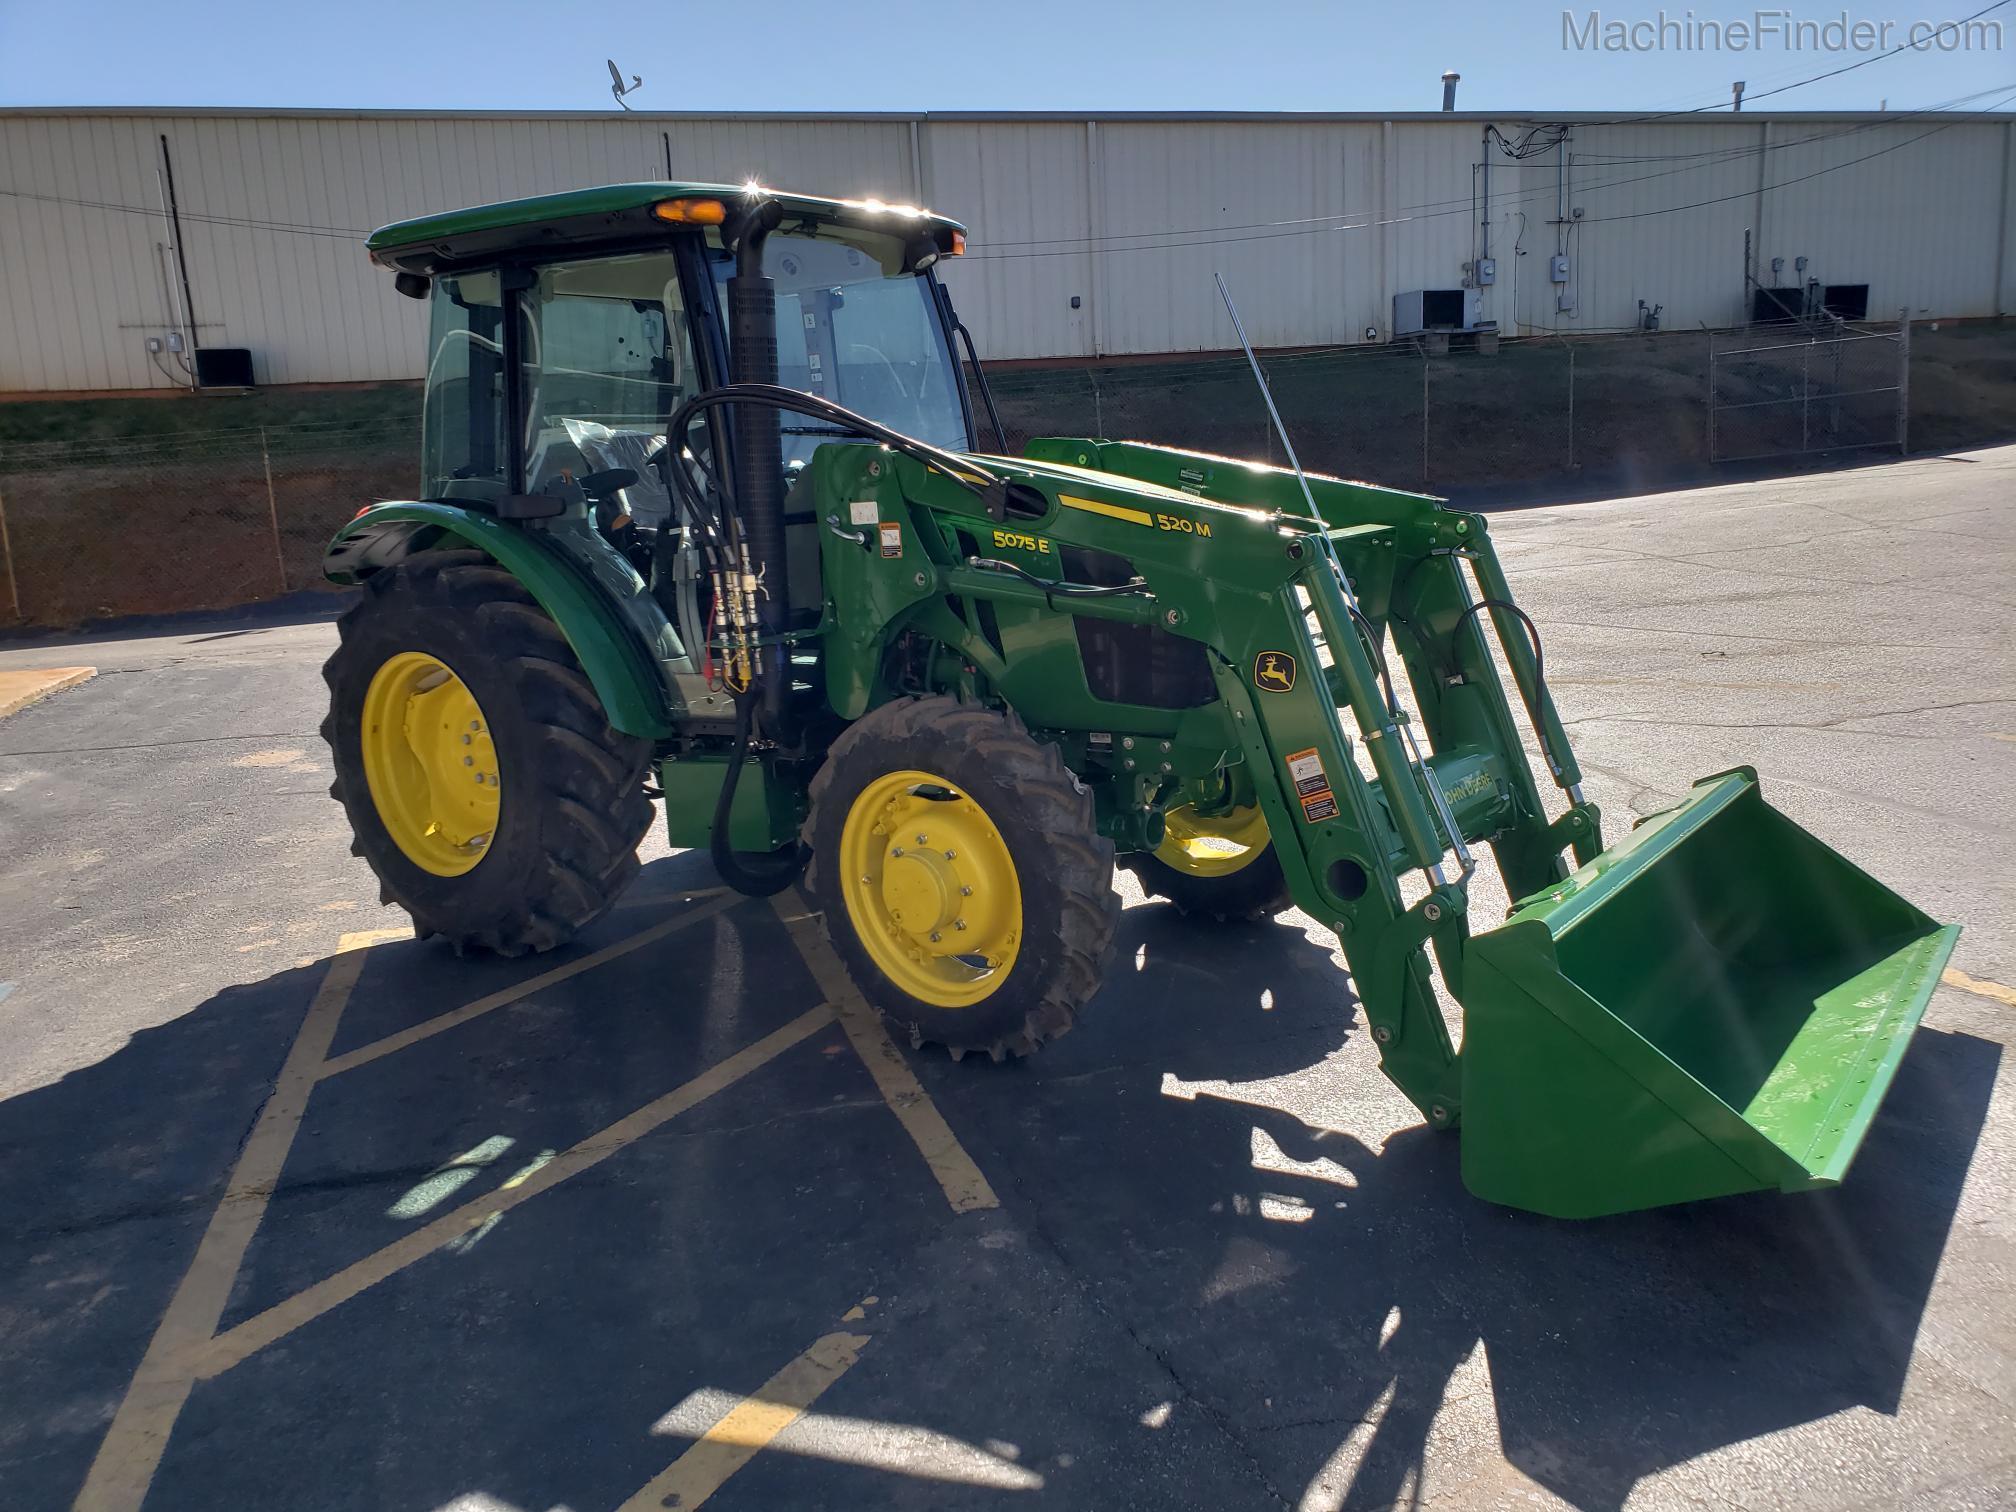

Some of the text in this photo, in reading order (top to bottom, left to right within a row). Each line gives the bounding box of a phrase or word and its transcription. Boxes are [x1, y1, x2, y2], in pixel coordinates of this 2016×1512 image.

[1156, 513, 1212, 538] 520 M
[993, 530, 1051, 554] 5075 E
[1444, 785, 1467, 805] OHN
